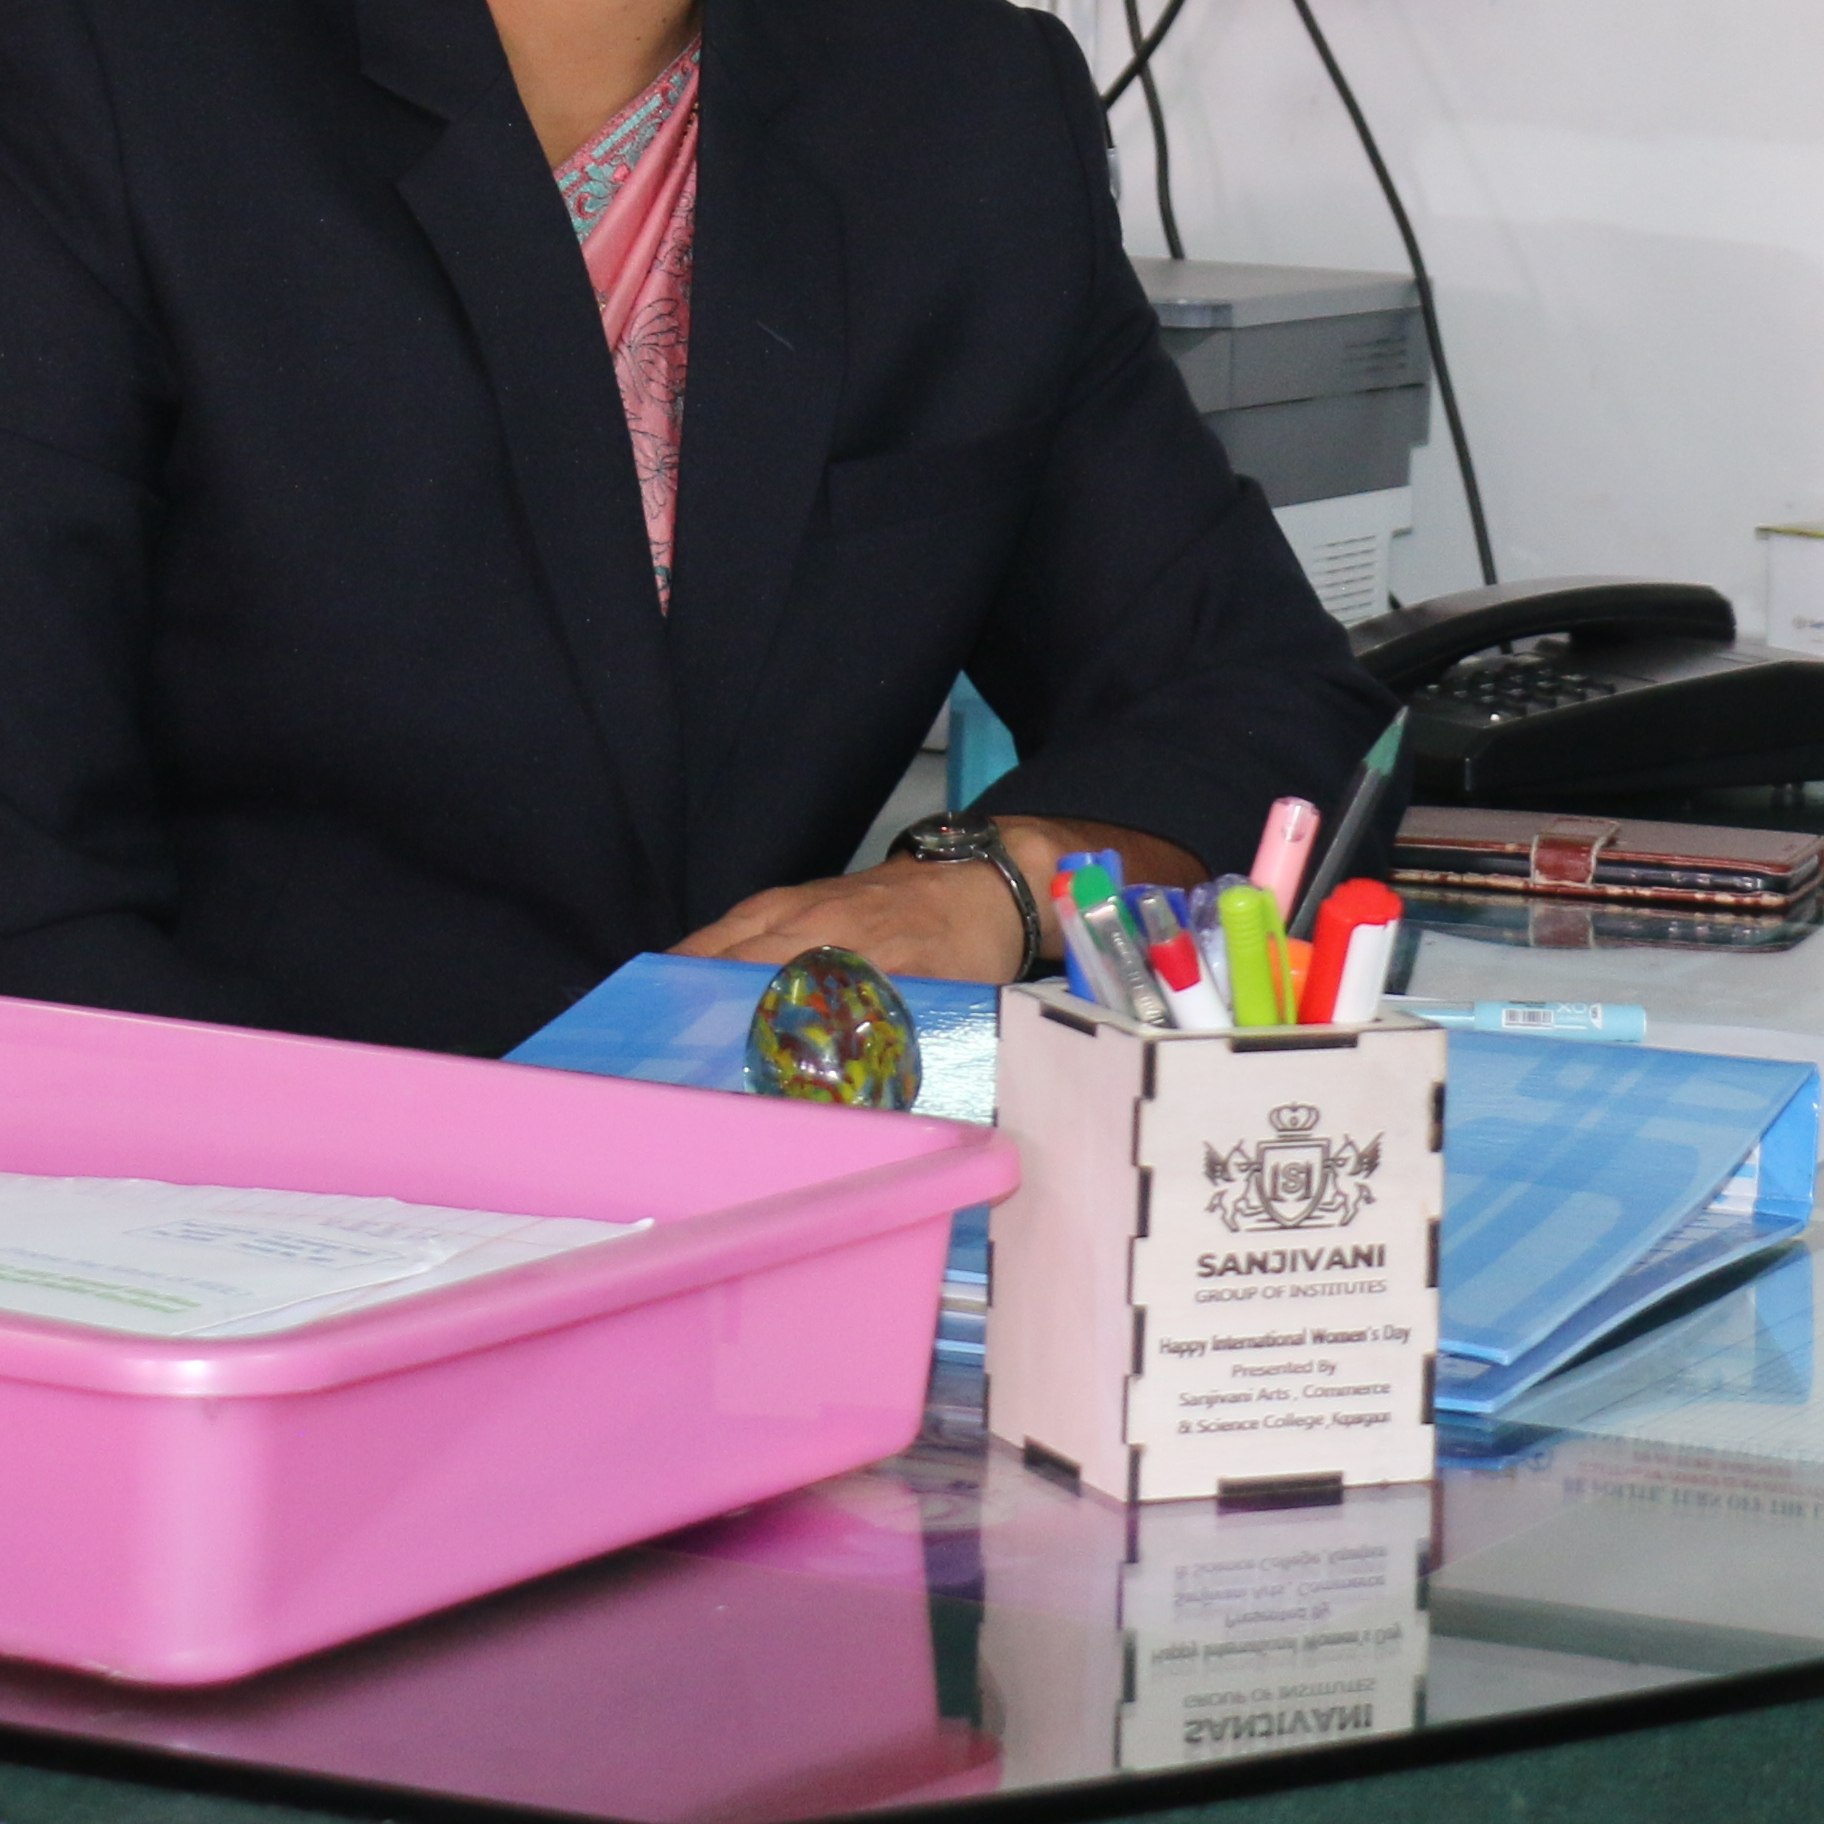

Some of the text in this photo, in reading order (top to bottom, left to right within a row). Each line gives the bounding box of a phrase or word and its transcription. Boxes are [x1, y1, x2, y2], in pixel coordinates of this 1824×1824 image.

[1195, 1243, 1387, 1277] SANJIVANI
[1194, 1278, 1388, 1304] GROUP OF INSTITUTES
[1159, 1337, 1207, 1358] Happy
[1211, 1330, 1307, 1352] International
[1383, 1324, 1412, 1344] Day
[1232, 1359, 1338, 1378] Presented By
[1179, 1389, 1253, 1408] Sanjivani
[1302, 1380, 1391, 1399] Commerce
[1178, 1419, 1194, 1435] &
[1197, 1416, 1260, 1434] Science
[1262, 1411, 1325, 1431] College
